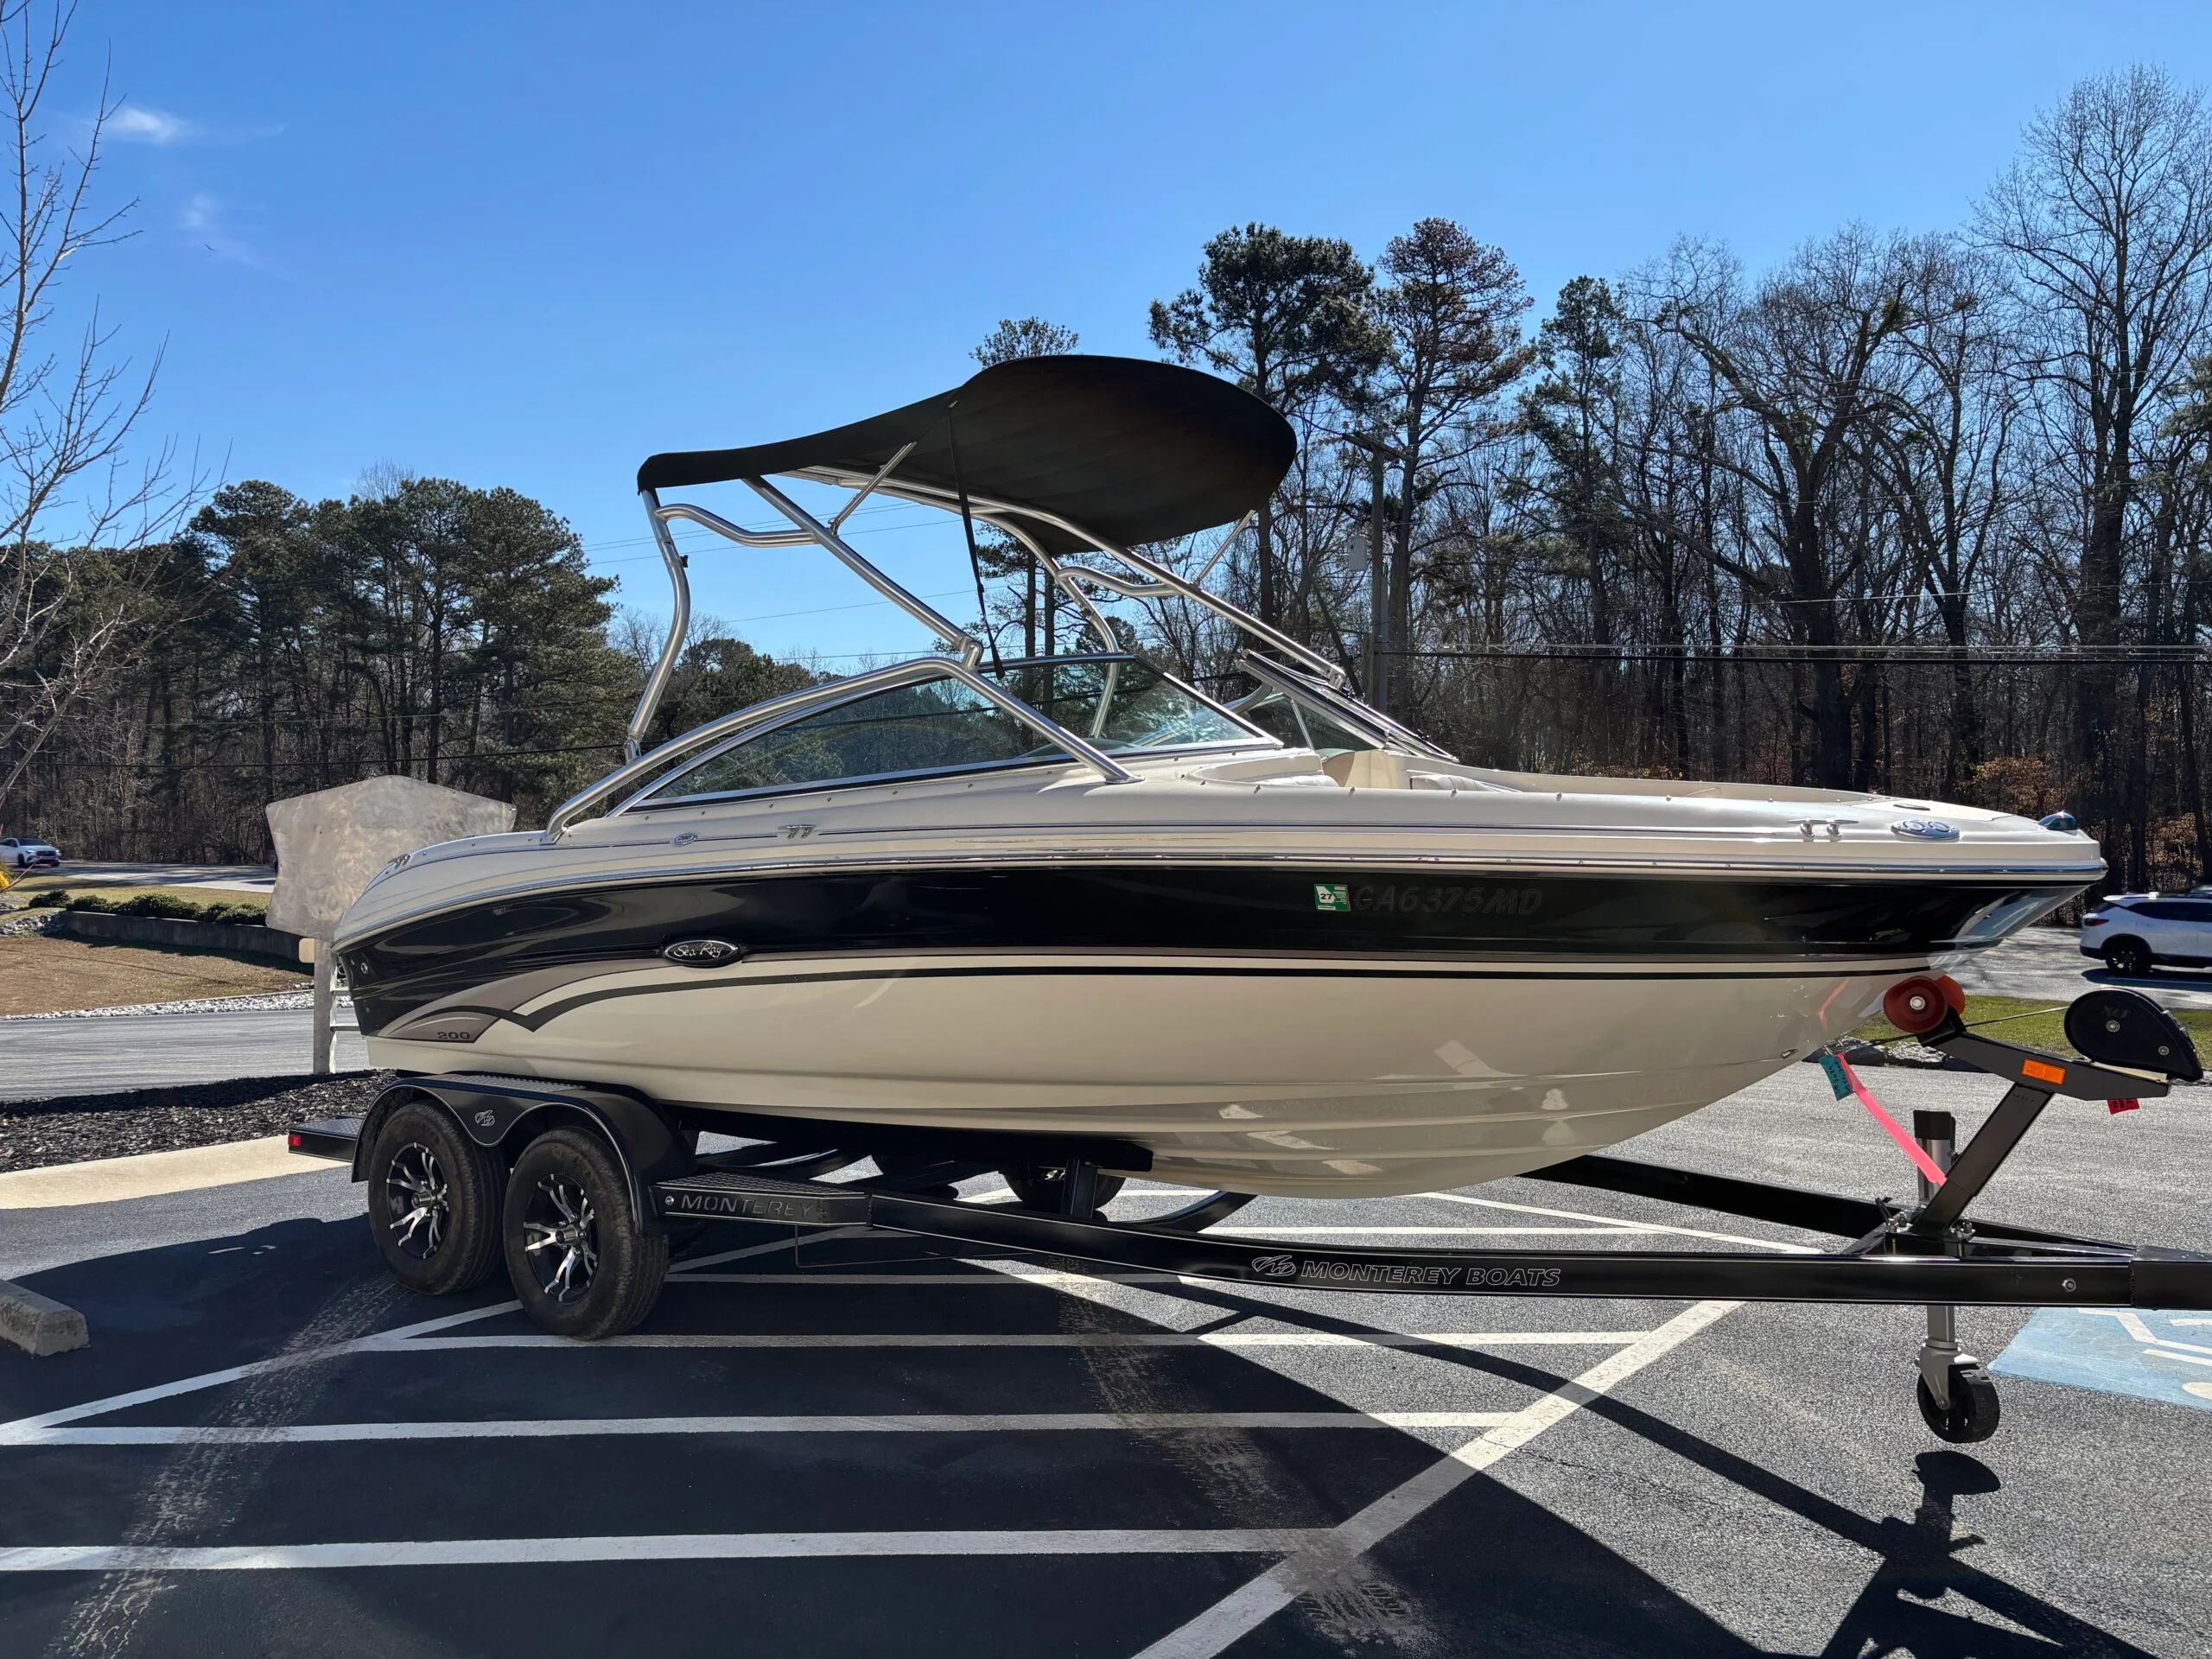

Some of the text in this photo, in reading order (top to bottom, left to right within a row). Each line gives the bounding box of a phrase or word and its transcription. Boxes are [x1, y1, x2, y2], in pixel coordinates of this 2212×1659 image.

[1354, 884, 1544, 915] GA6375MD
[674, 942, 724, 958] Sea Ray
[436, 1031, 471, 1039] 200
[680, 1193, 814, 1217] MONTEREY
[1300, 1260, 1561, 1287] MONTEREY BOATS
